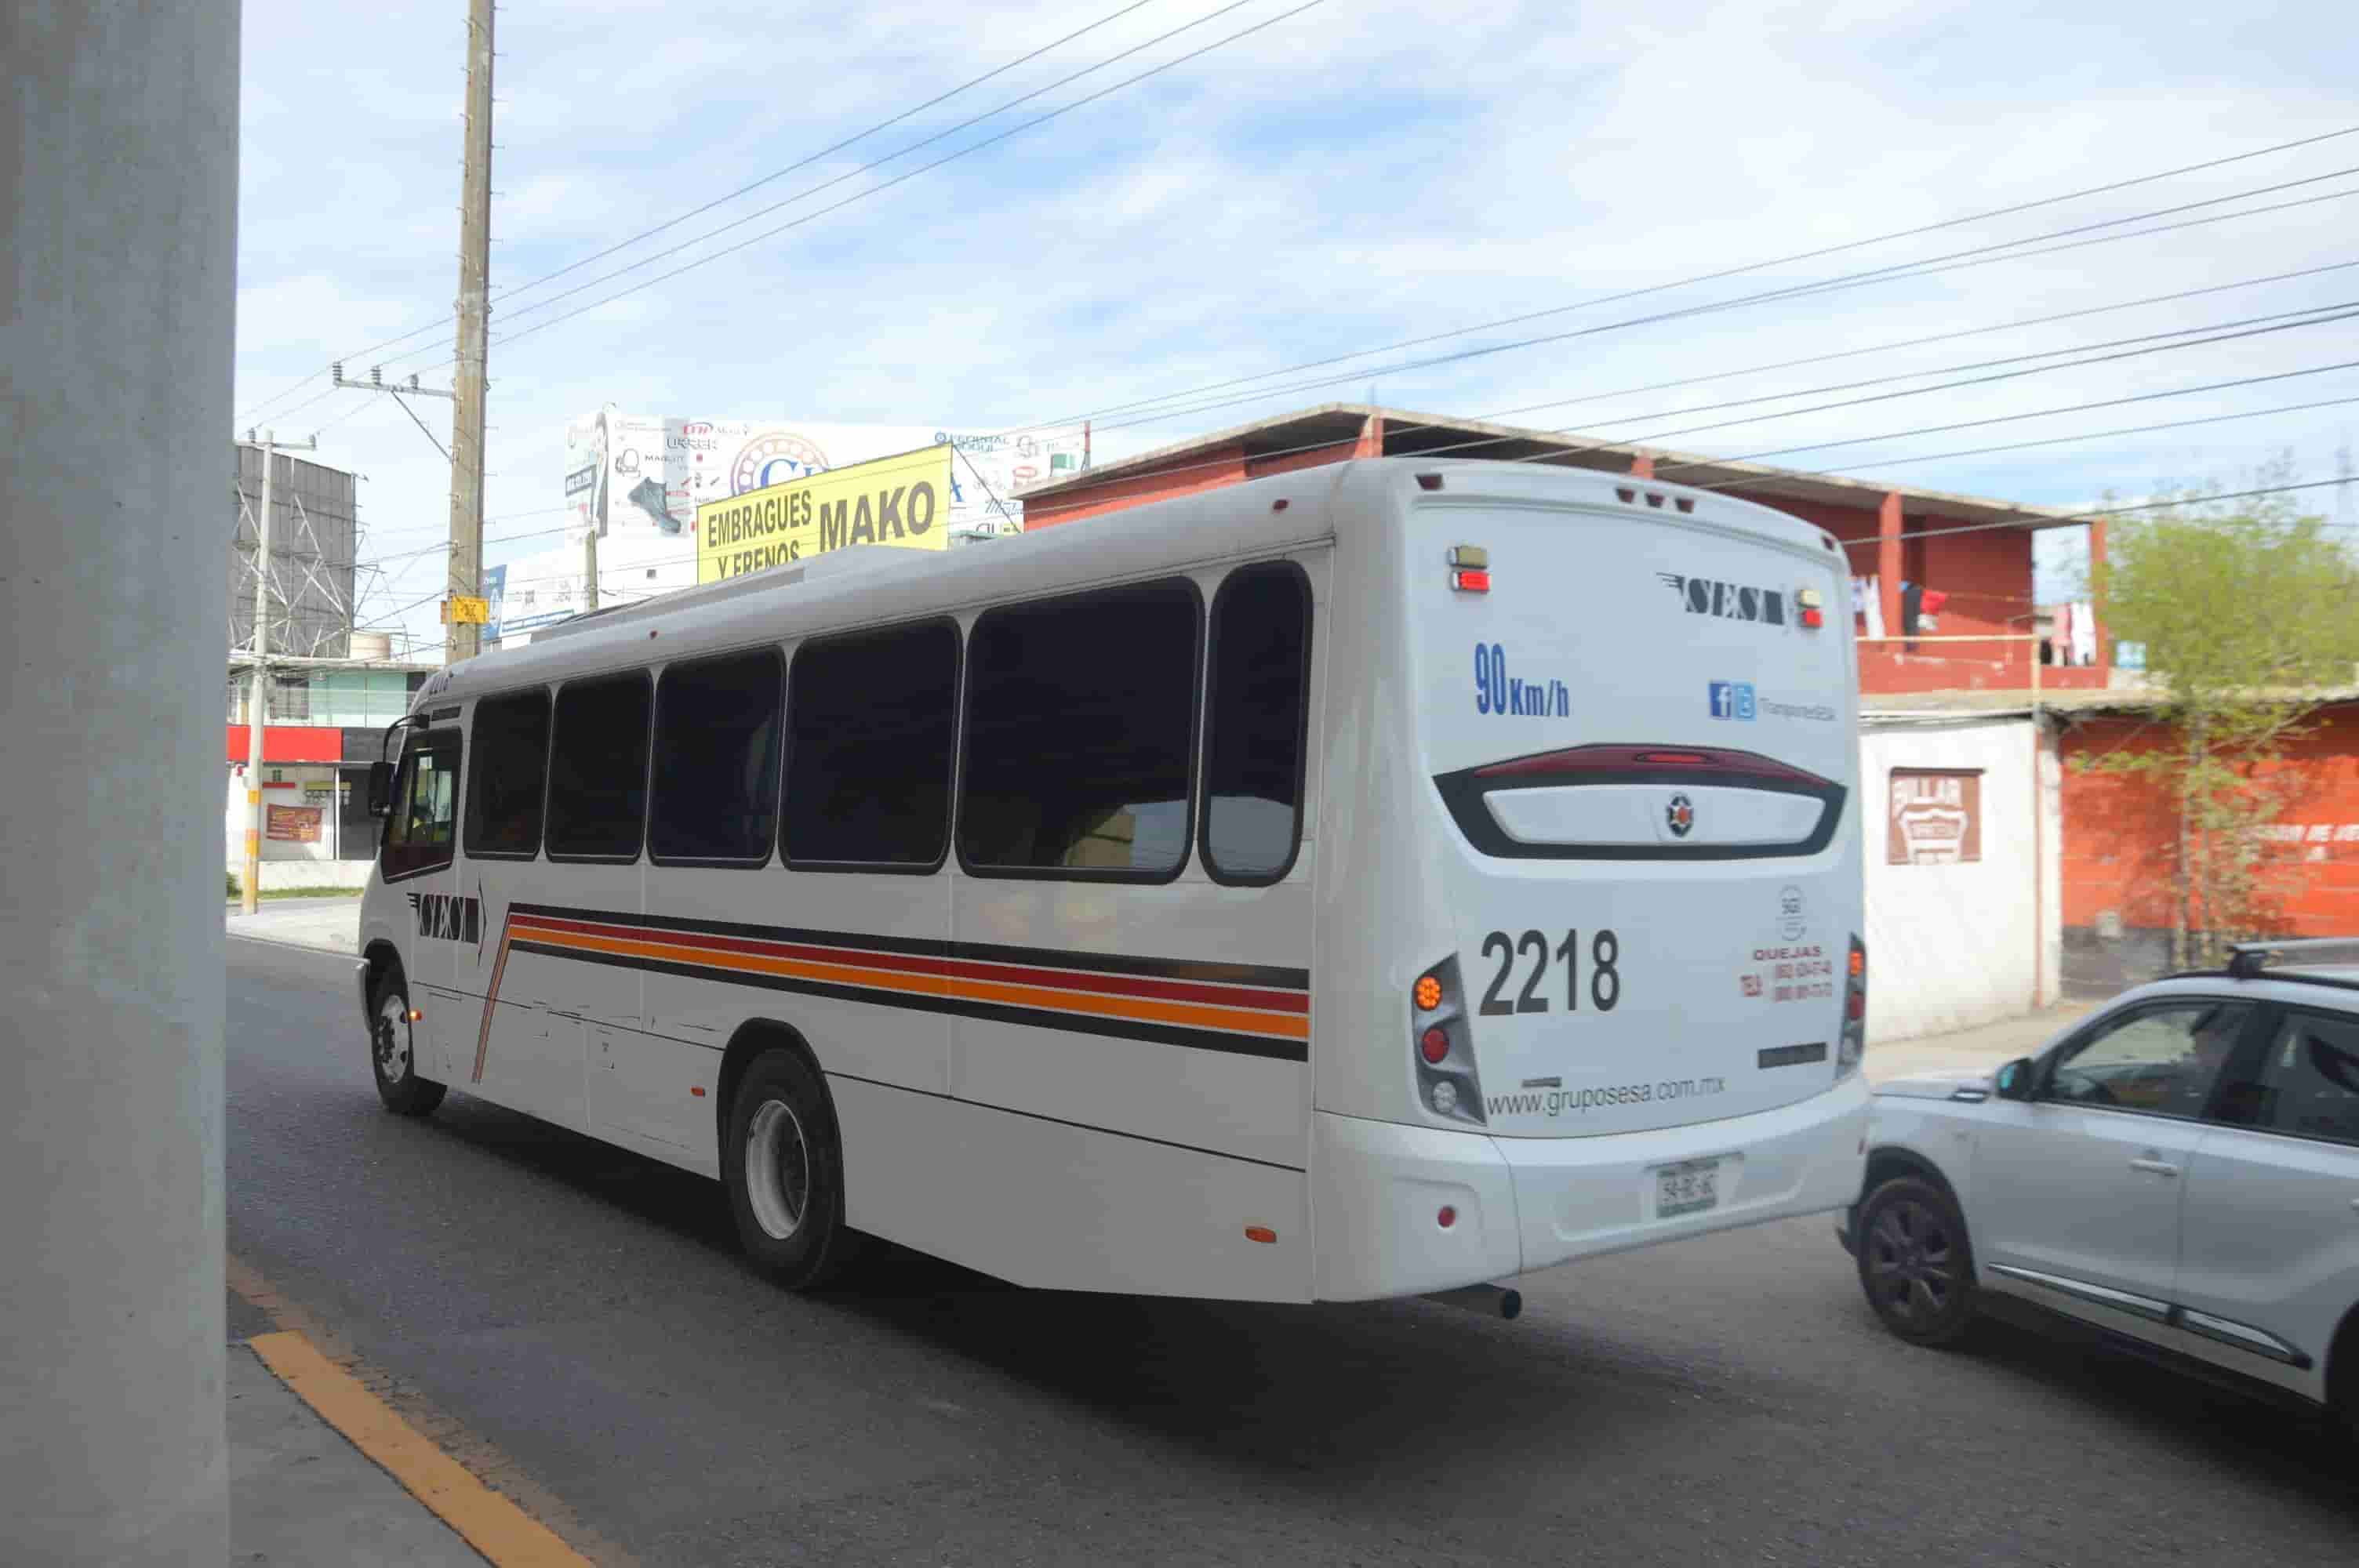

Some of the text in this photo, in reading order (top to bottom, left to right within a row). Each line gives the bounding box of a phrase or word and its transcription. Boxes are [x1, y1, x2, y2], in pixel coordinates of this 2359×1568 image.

[707, 489, 812, 547] EMBRAGUES
[820, 481, 935, 552] MAKO
[718, 556, 729, 579] Y
[733, 539, 799, 578] FRENOS
[1474, 642, 1570, 717] 90 Km/h
[1478, 927, 1620, 1017] 2218
